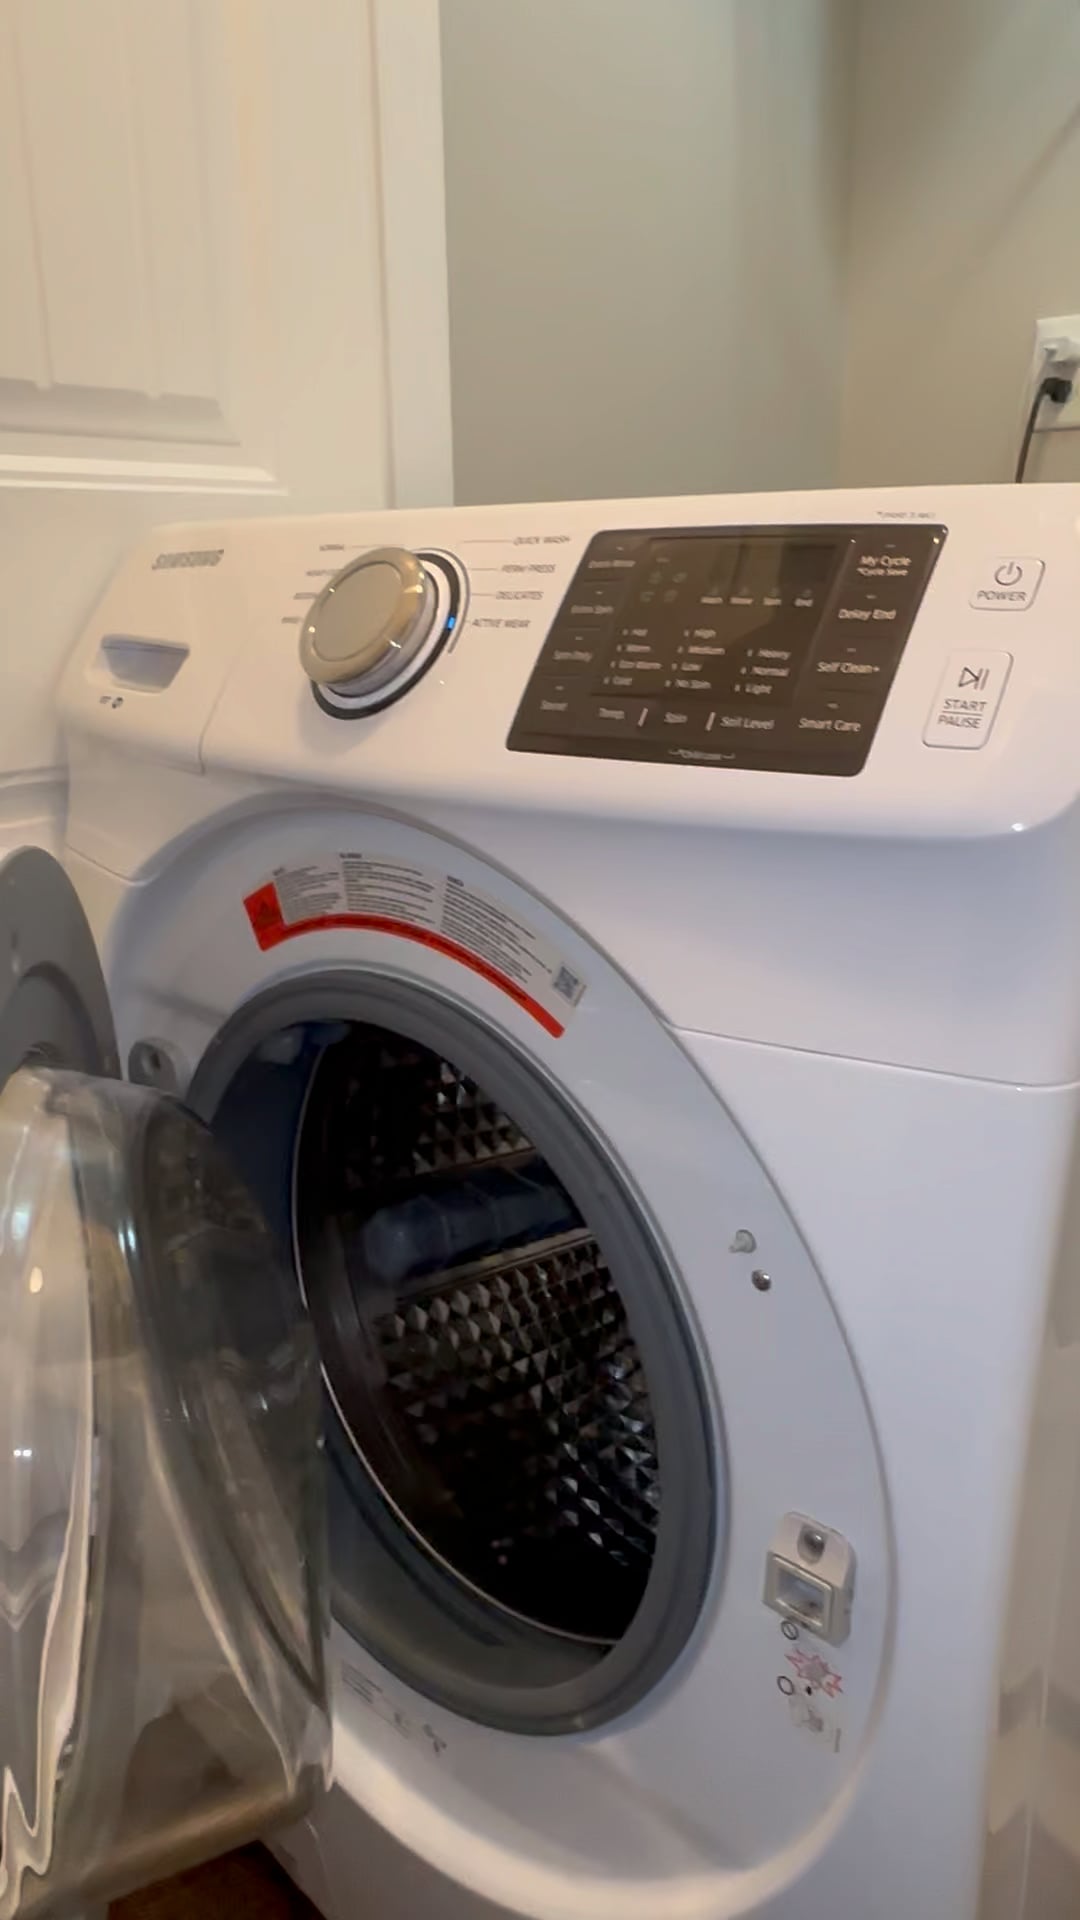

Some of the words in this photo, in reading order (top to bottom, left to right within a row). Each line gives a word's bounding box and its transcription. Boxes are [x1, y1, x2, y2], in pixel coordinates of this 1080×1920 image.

[860, 555, 878, 567] My
[880, 555, 911, 567] Cycle
[528, 564, 556, 573] PRESS
[496, 591, 544, 600] DELICATES
[977, 590, 1027, 602] POWER
[838, 608, 872, 621] Delay
[872, 608, 897, 620] End
[472, 619, 503, 628] ACTIVE
[504, 619, 531, 628] WEAR
[817, 661, 840, 673] Self
[943, 698, 987, 712] START
[720, 716, 742, 728] Soil
[743, 718, 775, 730] Level
[798, 717, 833, 730] Smart
[834, 720, 862, 732] Care
[937, 715, 982, 729] PAUSE
